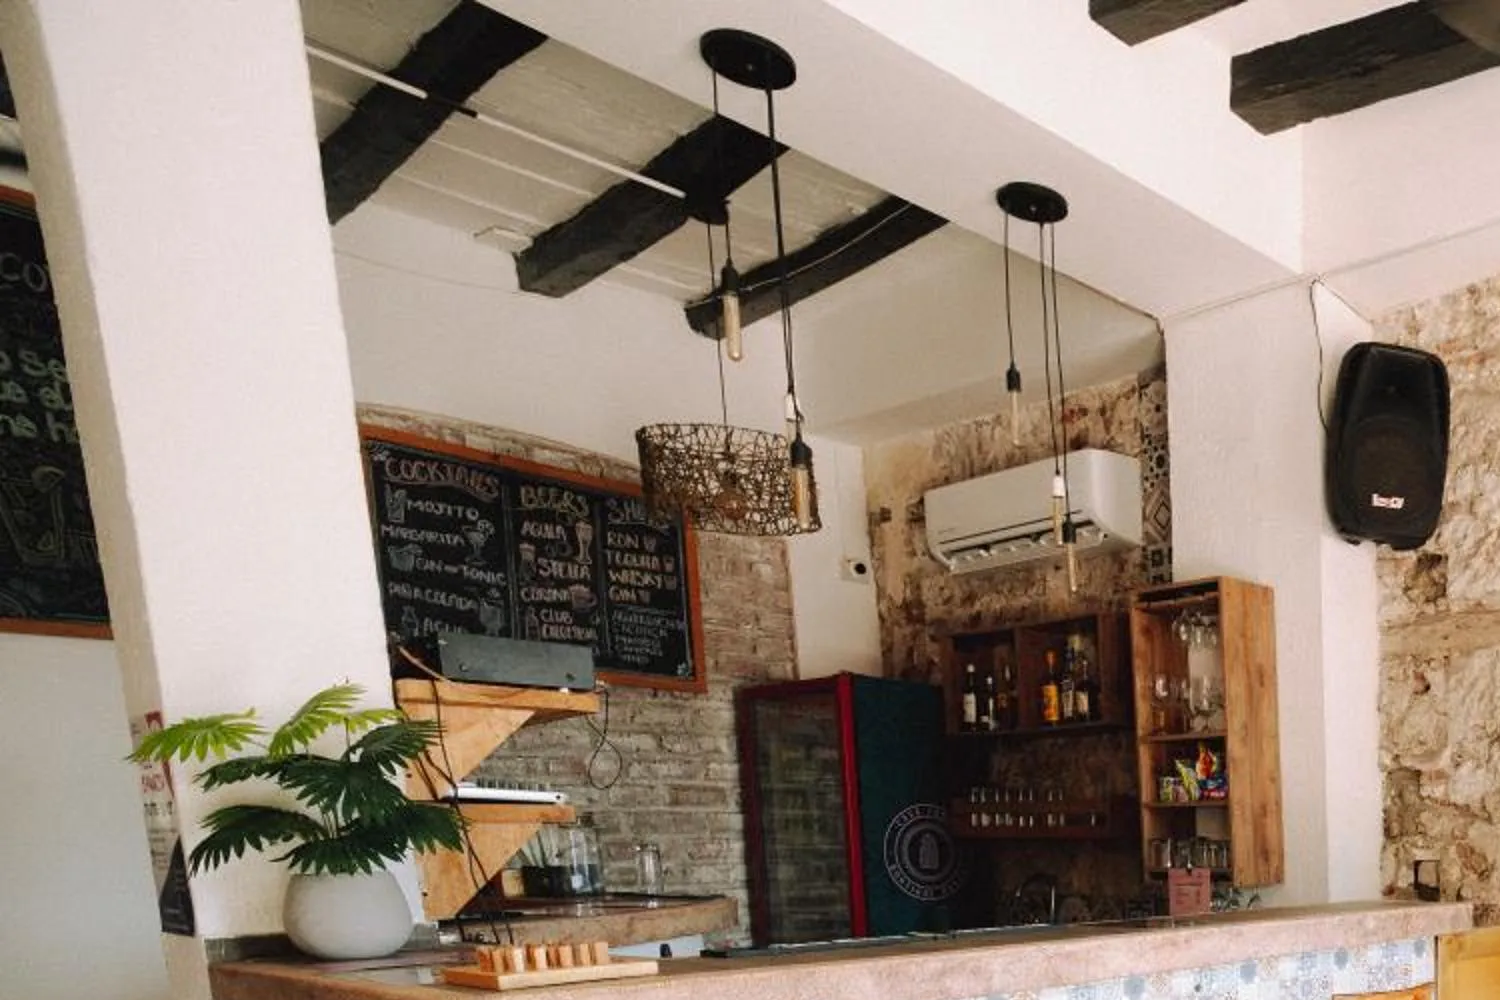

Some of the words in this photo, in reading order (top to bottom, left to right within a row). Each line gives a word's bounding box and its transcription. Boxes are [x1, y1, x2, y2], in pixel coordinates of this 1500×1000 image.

[406, 499, 480, 521] MOJITO
[520, 485, 589, 517] BEERS
[607, 530, 640, 549] RON
[462, 564, 507, 586] TONIC
